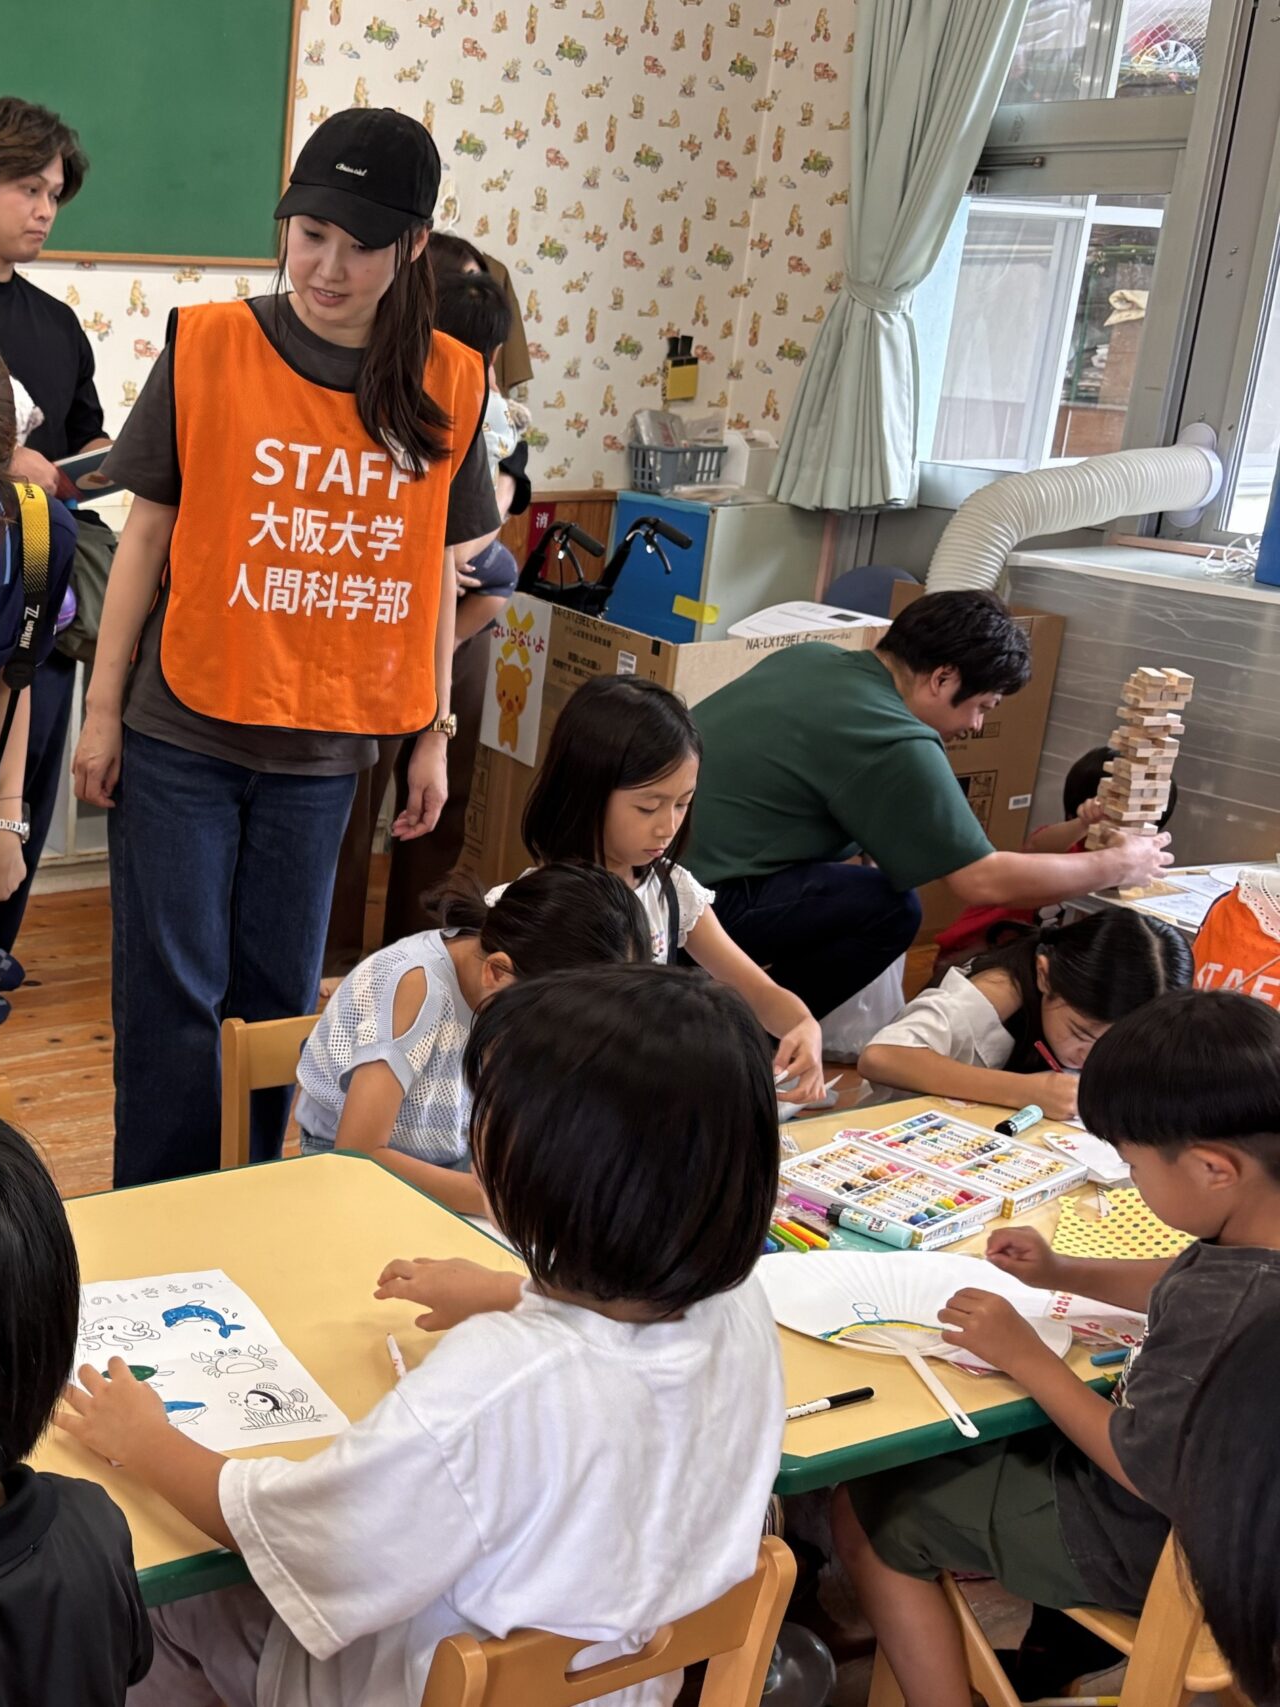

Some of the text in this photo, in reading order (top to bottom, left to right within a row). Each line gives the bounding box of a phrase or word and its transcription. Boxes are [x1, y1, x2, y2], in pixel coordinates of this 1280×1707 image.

[251, 438, 429, 500] STAFF
[248, 501, 404, 561] 大阪大学
[228, 563, 412, 625] 人間科学部
[19, 620, 35, 649] Nikon
